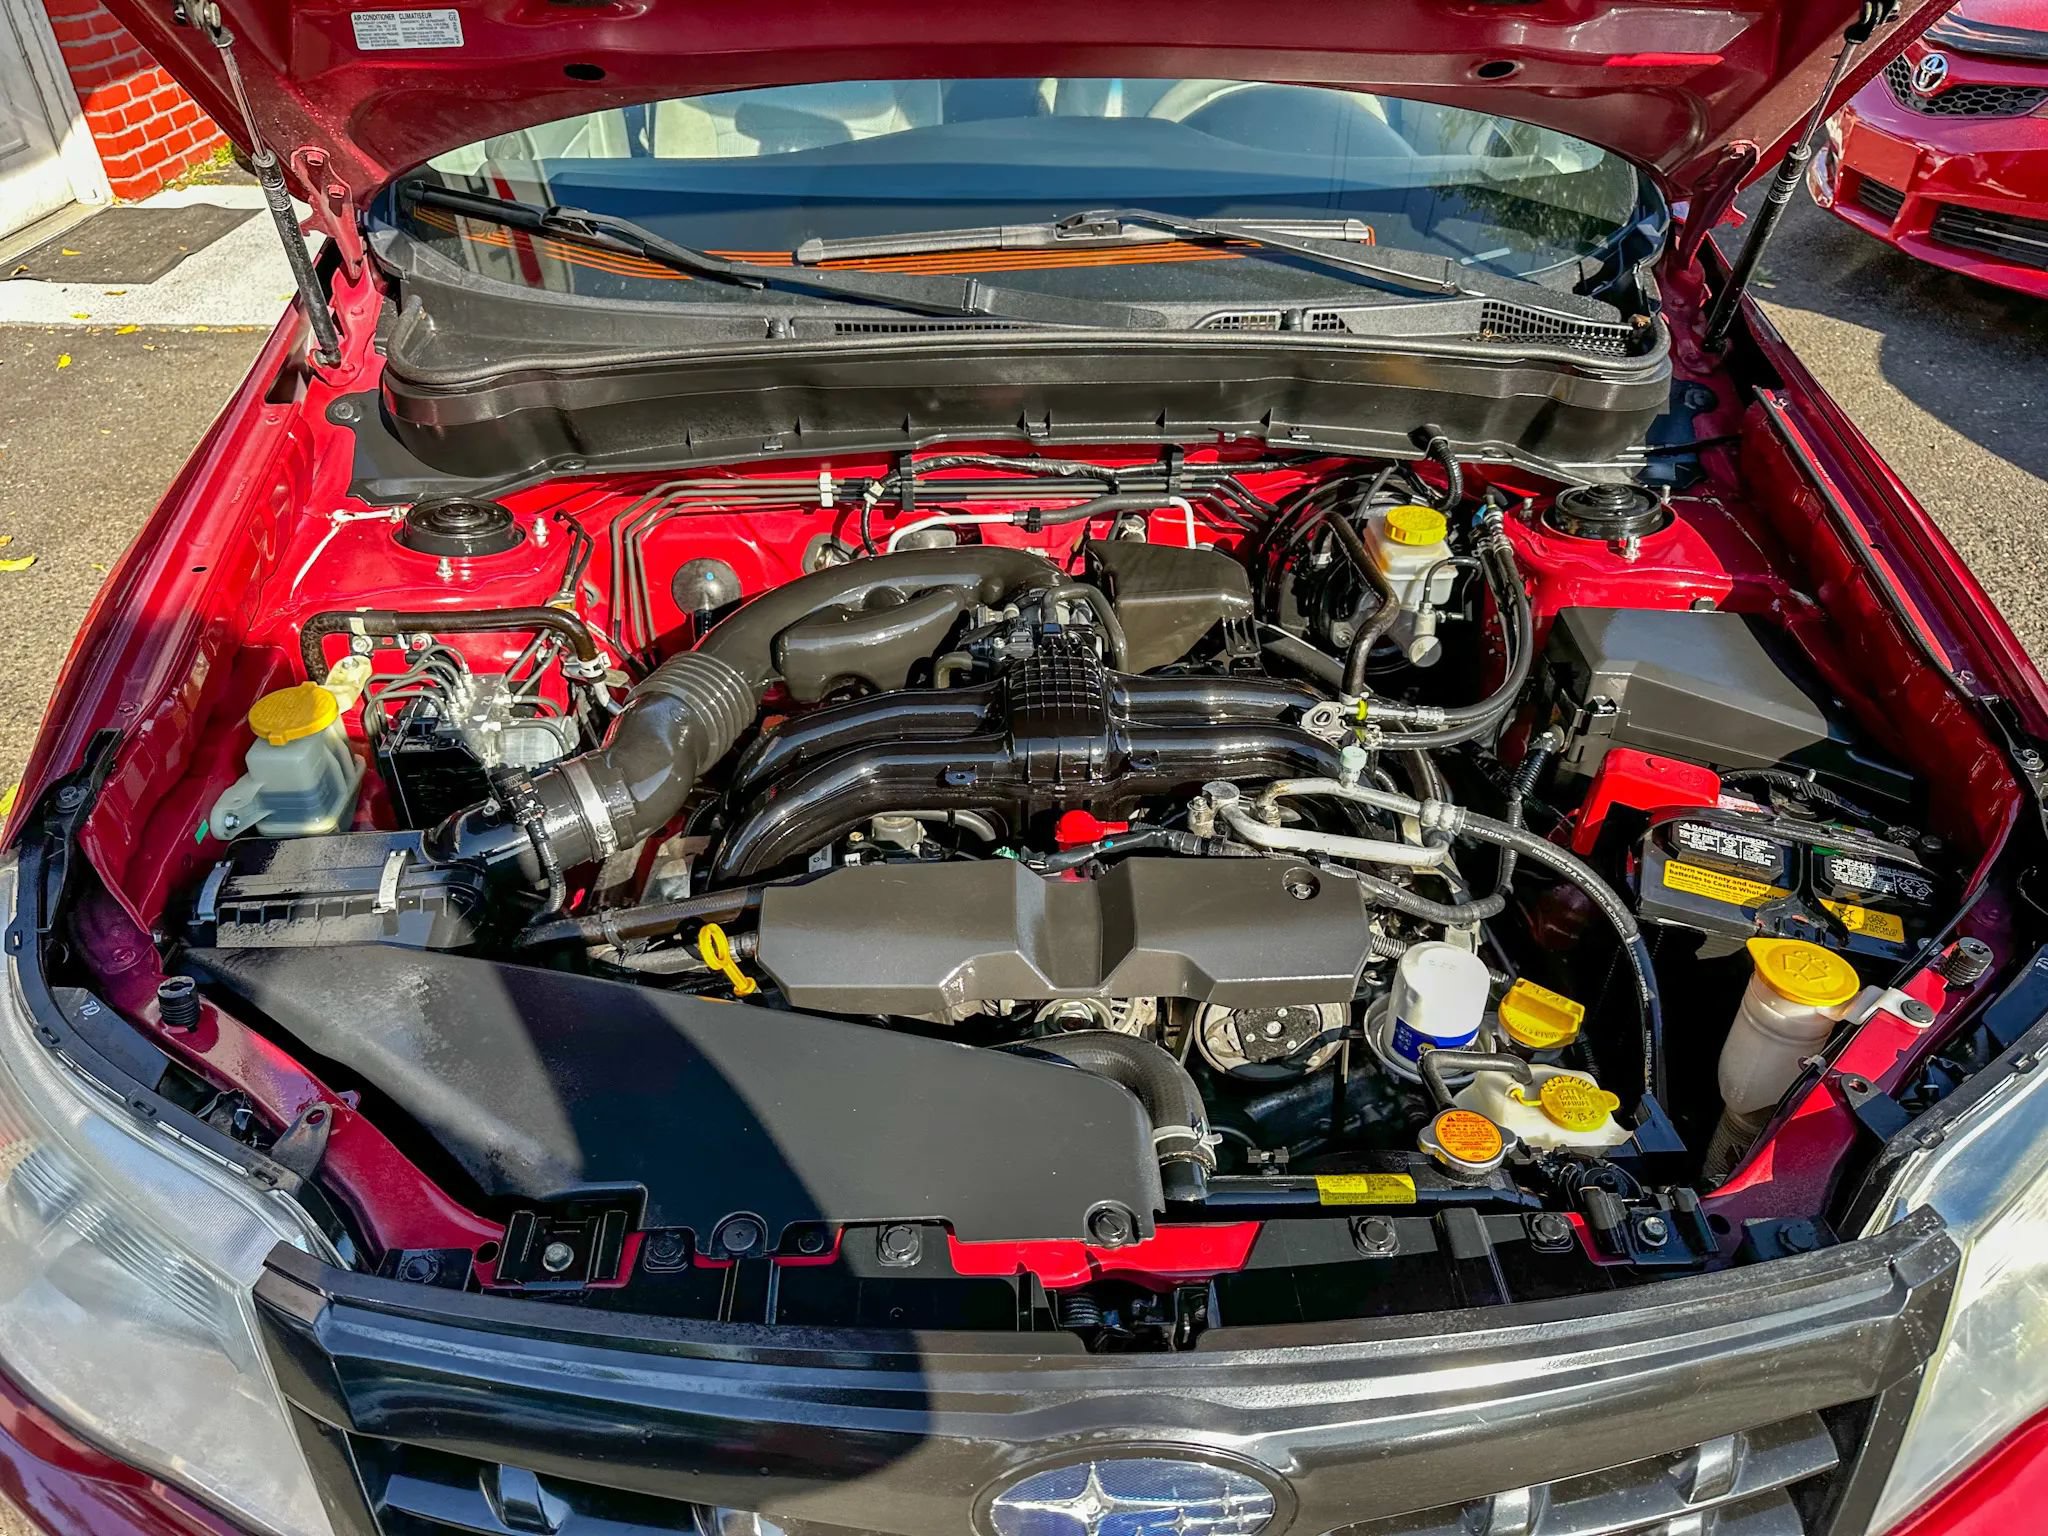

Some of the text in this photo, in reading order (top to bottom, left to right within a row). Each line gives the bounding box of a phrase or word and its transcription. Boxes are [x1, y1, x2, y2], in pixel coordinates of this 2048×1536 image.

[398, 12, 432, 20] CLIMATISEUR
[1691, 824, 1727, 840] DANGER
[1736, 834, 1769, 846] POISON
[1461, 823, 1511, 843] R>EPDM<
[1531, 848, 1584, 882] INNER>PA<
[1669, 862, 1696, 873] Return
[1696, 868, 1731, 883] warranty
[1732, 877, 1747, 887] and
[1748, 881, 1768, 891] used
[1669, 869, 1702, 881] batteries
[1713, 880, 1738, 891] Costco
